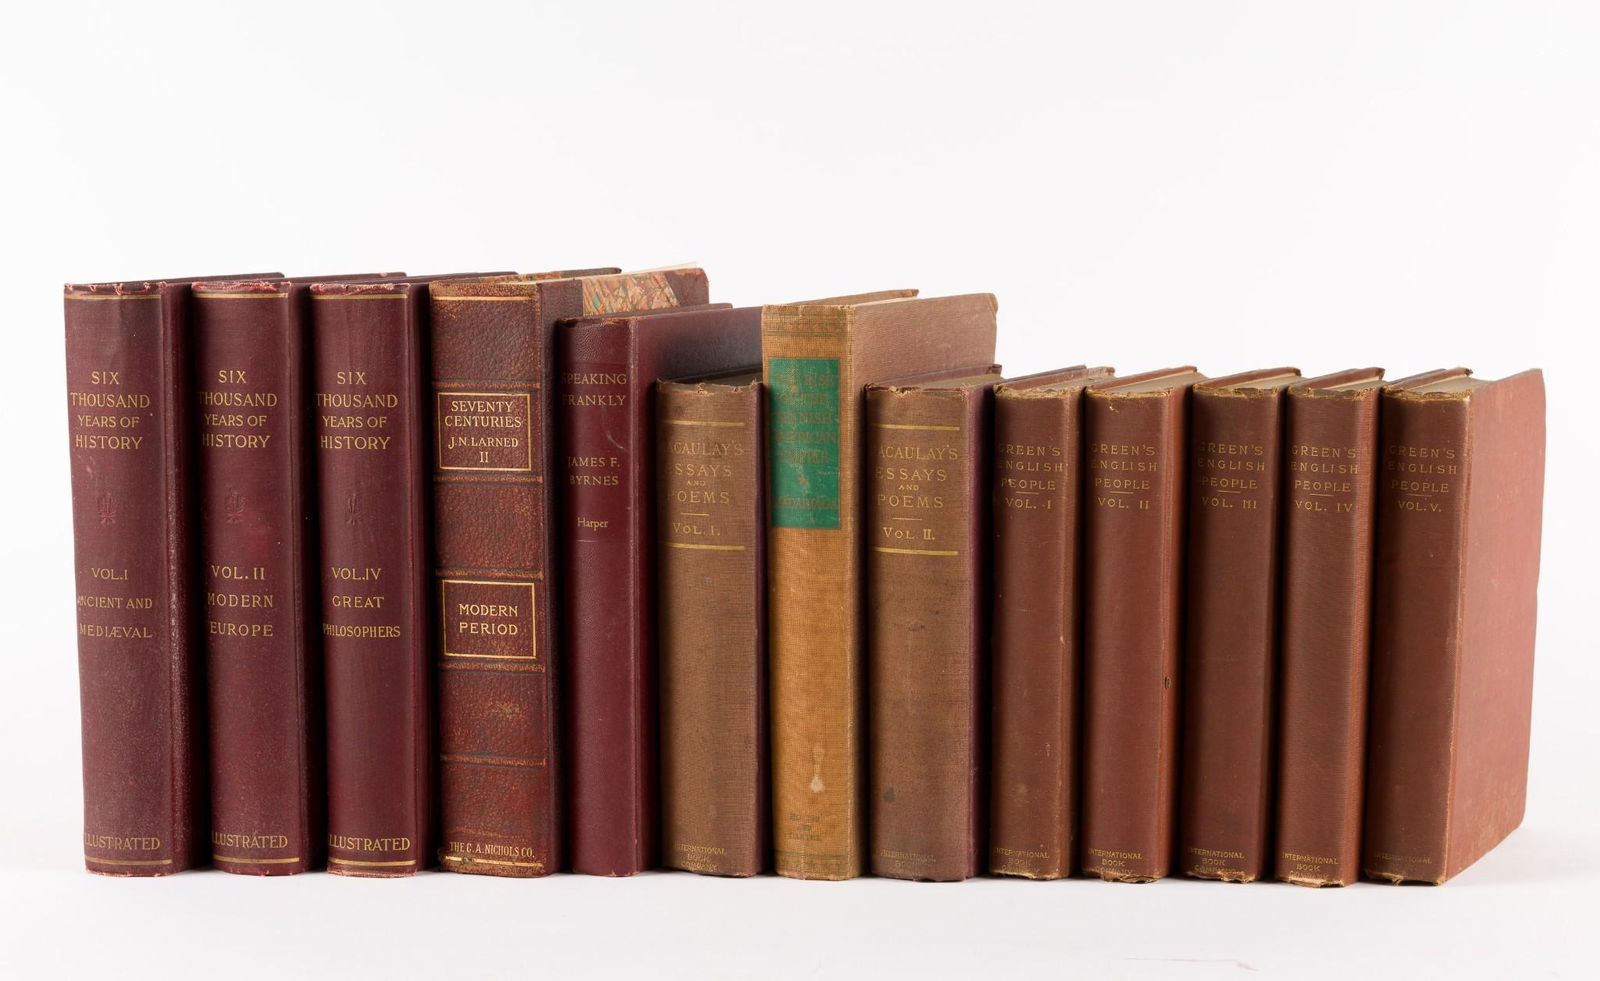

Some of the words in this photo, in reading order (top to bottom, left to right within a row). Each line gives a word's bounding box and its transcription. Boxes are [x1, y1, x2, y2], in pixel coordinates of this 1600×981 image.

[91, 371, 119, 385] SIX
[218, 370, 247, 384] SIX
[336, 371, 366, 385] SIX
[561, 373, 627, 385] PEAKING
[70, 392, 150, 408] THOUSAND
[197, 391, 278, 407] THOUSAND
[315, 392, 399, 408] THOUSAND
[451, 401, 514, 413] SEVENTY
[77, 415, 116, 428] YEARS
[120, 415, 140, 429] OF
[203, 413, 244, 427] YEARS
[247, 415, 268, 427] OF
[321, 415, 364, 428] YEARS
[366, 416, 388, 429] OF
[444, 416, 522, 428] CENTURIES
[75, 434, 143, 450] HISTORY
[202, 433, 271, 448] HISTORY
[320, 435, 391, 450] HISTORY
[479, 451, 489, 463] II
[880, 444, 959, 460] ACAULAY'S
[567, 456, 606, 468] JAMES
[610, 457, 621, 468] F.
[1197, 457, 1266, 472] ENGLISH
[1290, 461, 1360, 474] ENGLISH
[1387, 460, 1458, 475] ENGLISH
[674, 463, 732, 477] SSAYS
[875, 467, 947, 482] ESSAYS
[569, 474, 619, 486] BYRNES
[1000, 478, 1057, 491] PEOPLE
[1095, 477, 1151, 490] PEOPLE
[1201, 476, 1258, 490] PEOPLE
[1294, 479, 1351, 492] PEOPLE
[1391, 479, 1449, 493] PEOPLE
[677, 490, 730, 504] OEMS
[877, 495, 944, 509] POEMS
[1005, 497, 1037, 510] VOL.
[1047, 500, 1052, 510] I
[1097, 496, 1129, 509] VOL.
[1139, 500, 1152, 510] II
[1201, 496, 1233, 508] VOL.
[1242, 499, 1257, 509] III
[1295, 500, 1328, 512] VOL.
[1336, 503, 1353, 513] IV
[577, 516, 609, 531] Harper
[923, 528, 935, 540] II.
[211, 565, 249, 580] VOL.
[253, 567, 265, 580] II
[77, 595, 123, 609] ANCIENT
[126, 597, 153, 609] AND
[207, 591, 273, 608] MODERN
[332, 595, 385, 609] GREAT
[458, 603, 518, 617] MODERN
[210, 621, 273, 637] EUROPE
[322, 623, 401, 638] PHILOSOPHERS
[459, 622, 518, 635] PERIOD
[84, 832, 161, 850] LLUSTRATED
[450, 841, 465, 853] THE
[521, 847, 535, 858] CO.
[1282, 851, 1339, 865] INTERNATIONAL
